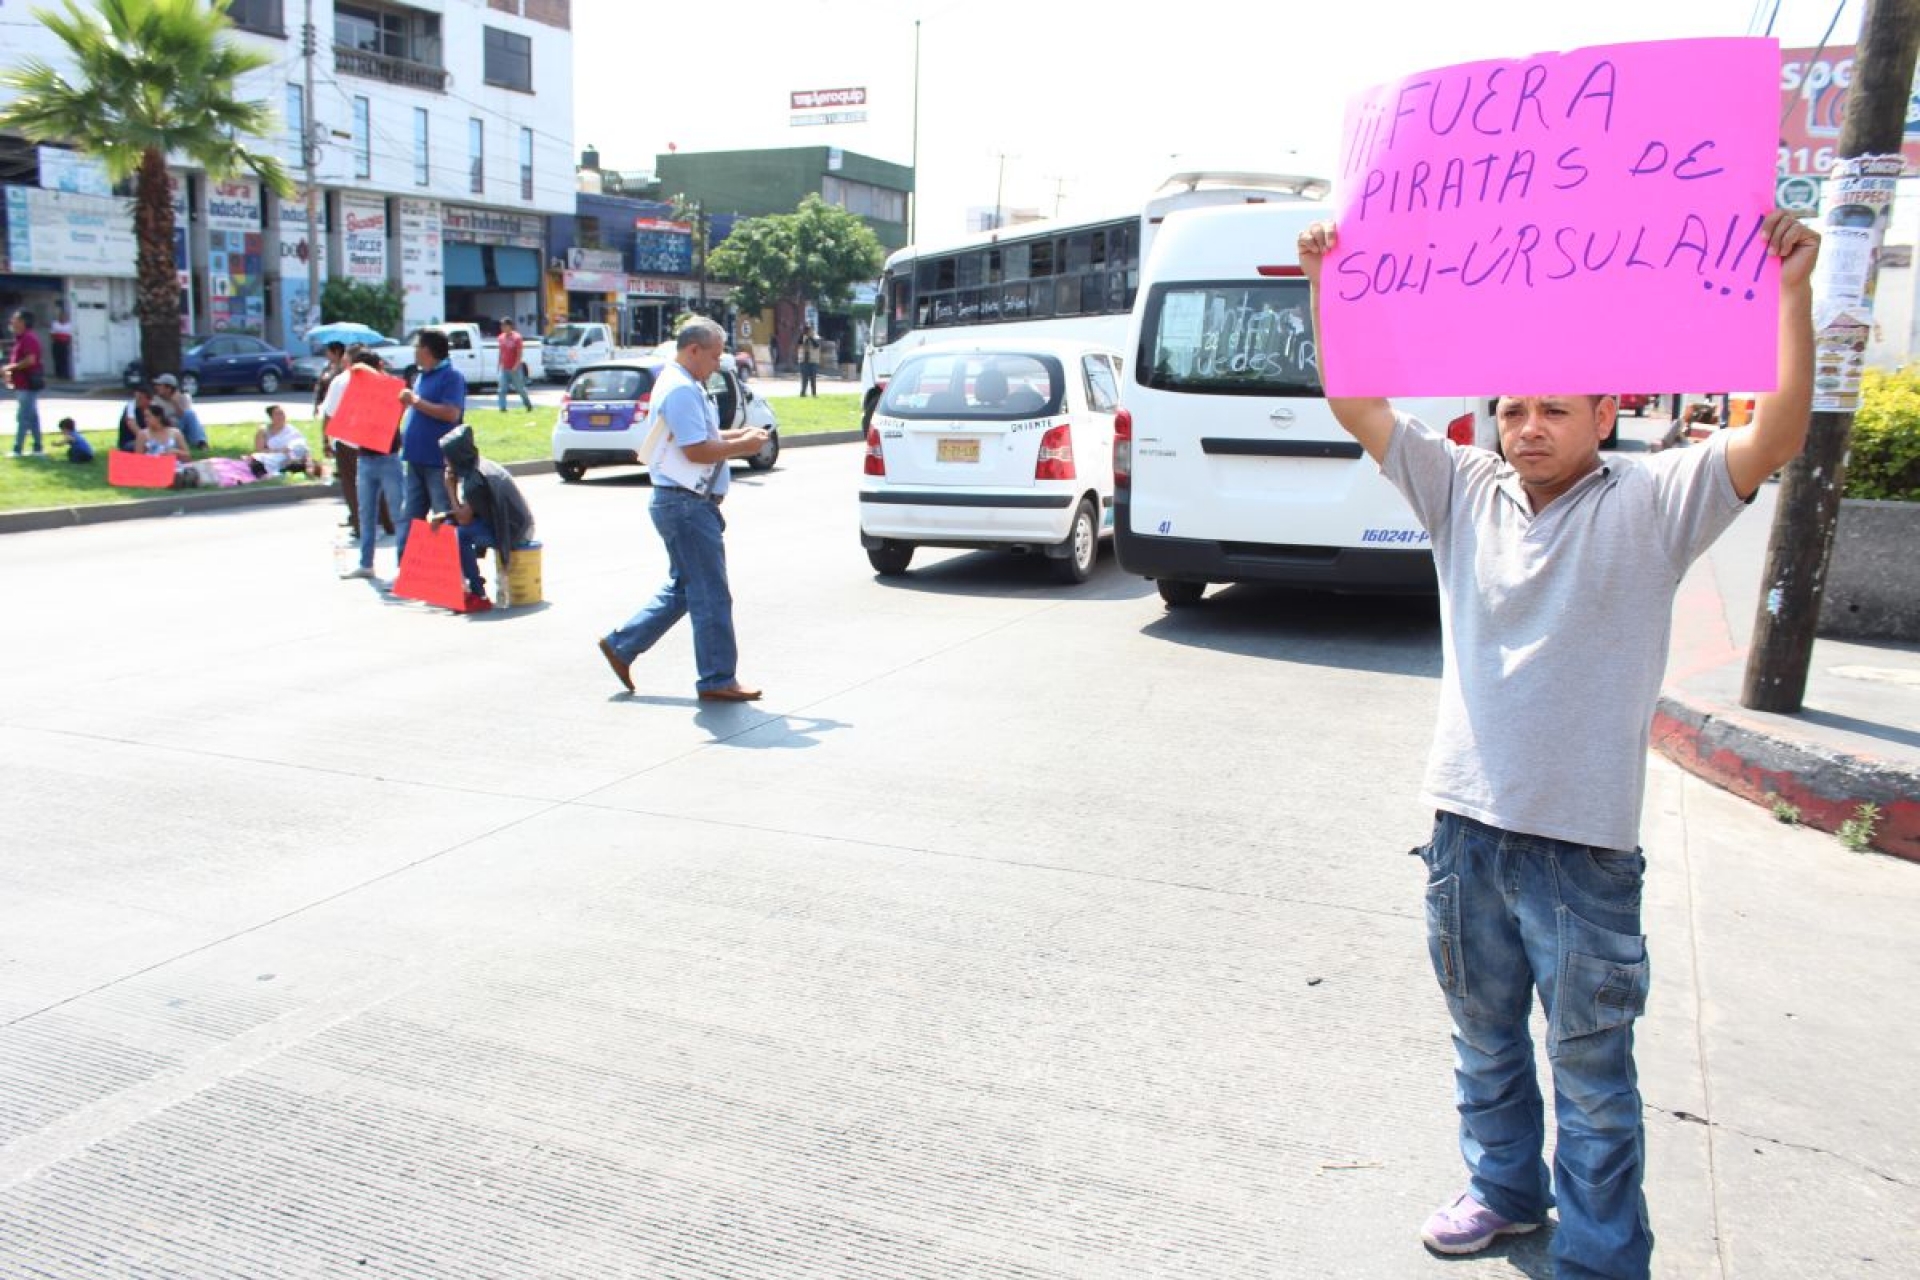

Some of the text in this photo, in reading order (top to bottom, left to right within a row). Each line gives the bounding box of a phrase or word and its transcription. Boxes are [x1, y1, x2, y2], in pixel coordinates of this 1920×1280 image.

[1359, 140, 1725, 221] PIRATAS DE
[1157, 520, 1172, 535] 41
